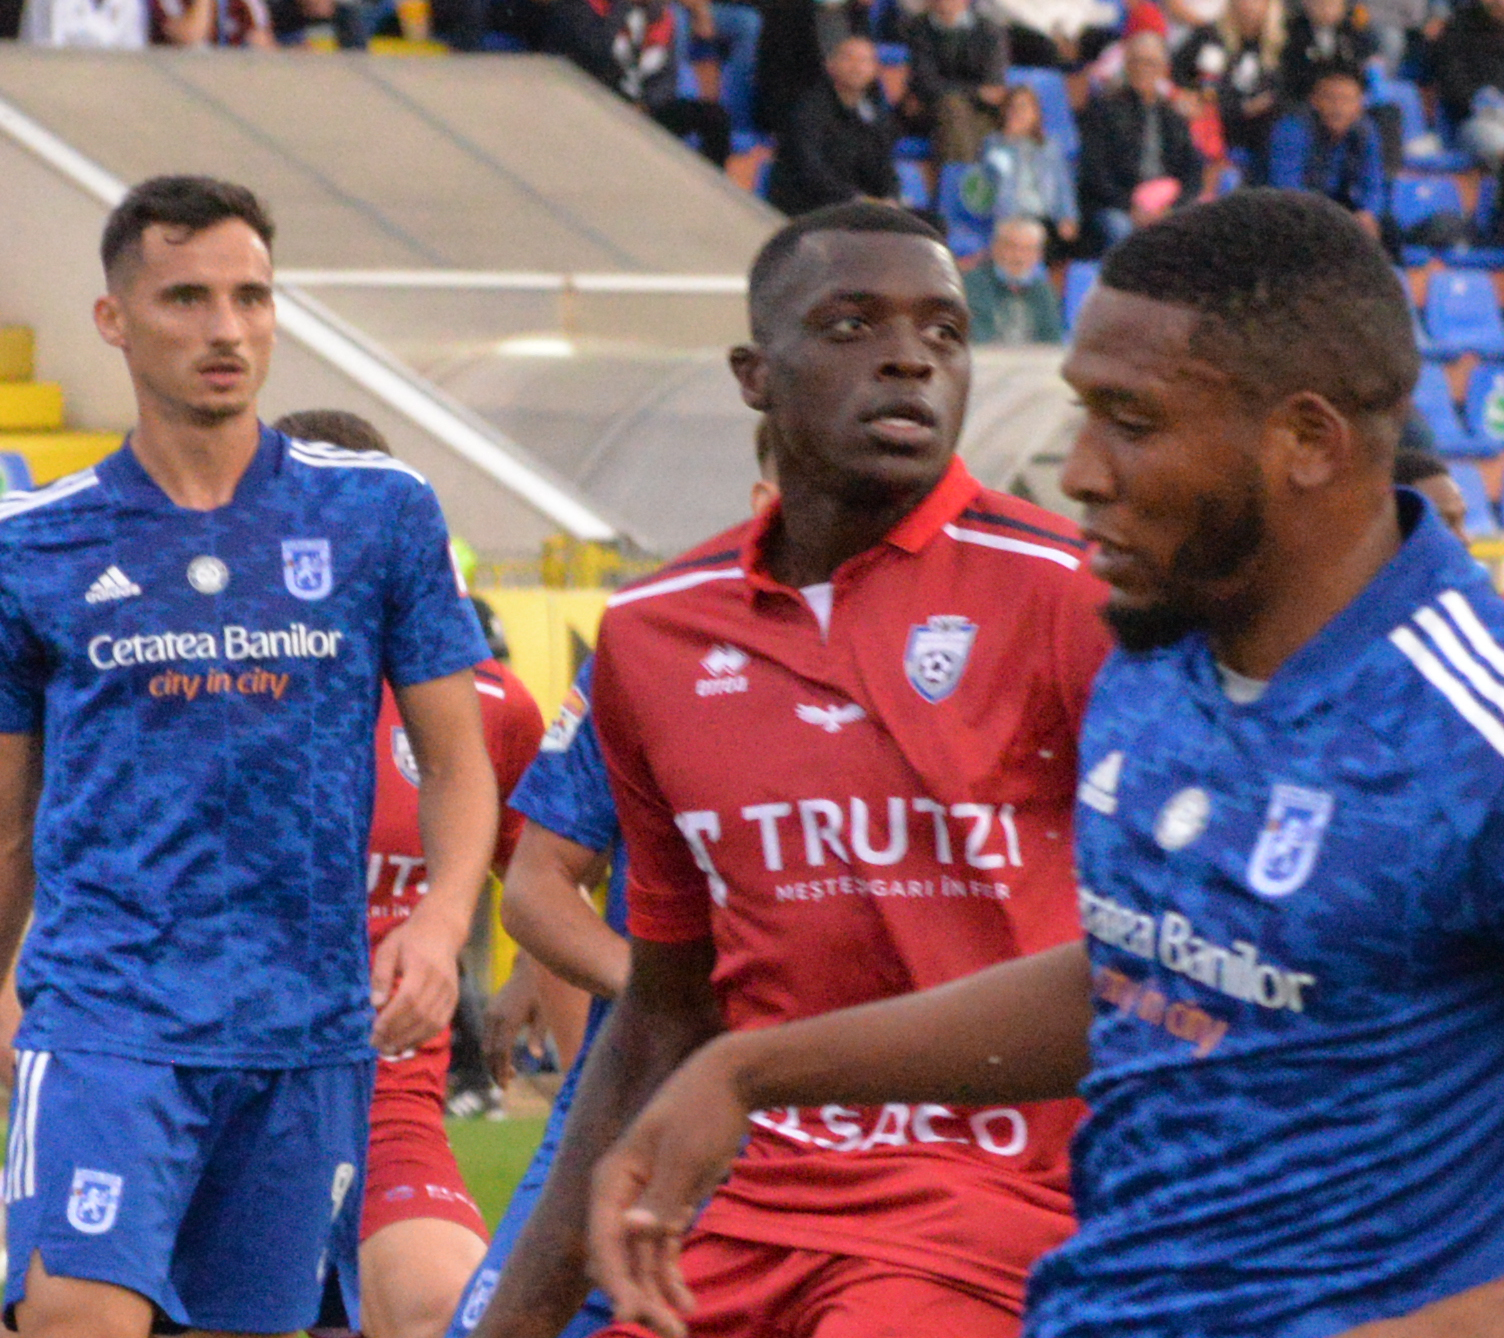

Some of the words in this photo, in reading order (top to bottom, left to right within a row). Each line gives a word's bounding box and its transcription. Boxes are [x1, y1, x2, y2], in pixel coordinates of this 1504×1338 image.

[88, 632, 217, 671] Cetatea
[223, 623, 344, 661] Banilor
[149, 669, 200, 702] city
[206, 668, 231, 694] in
[237, 667, 290, 700] city
[741, 796, 1024, 872] TRUTZI
